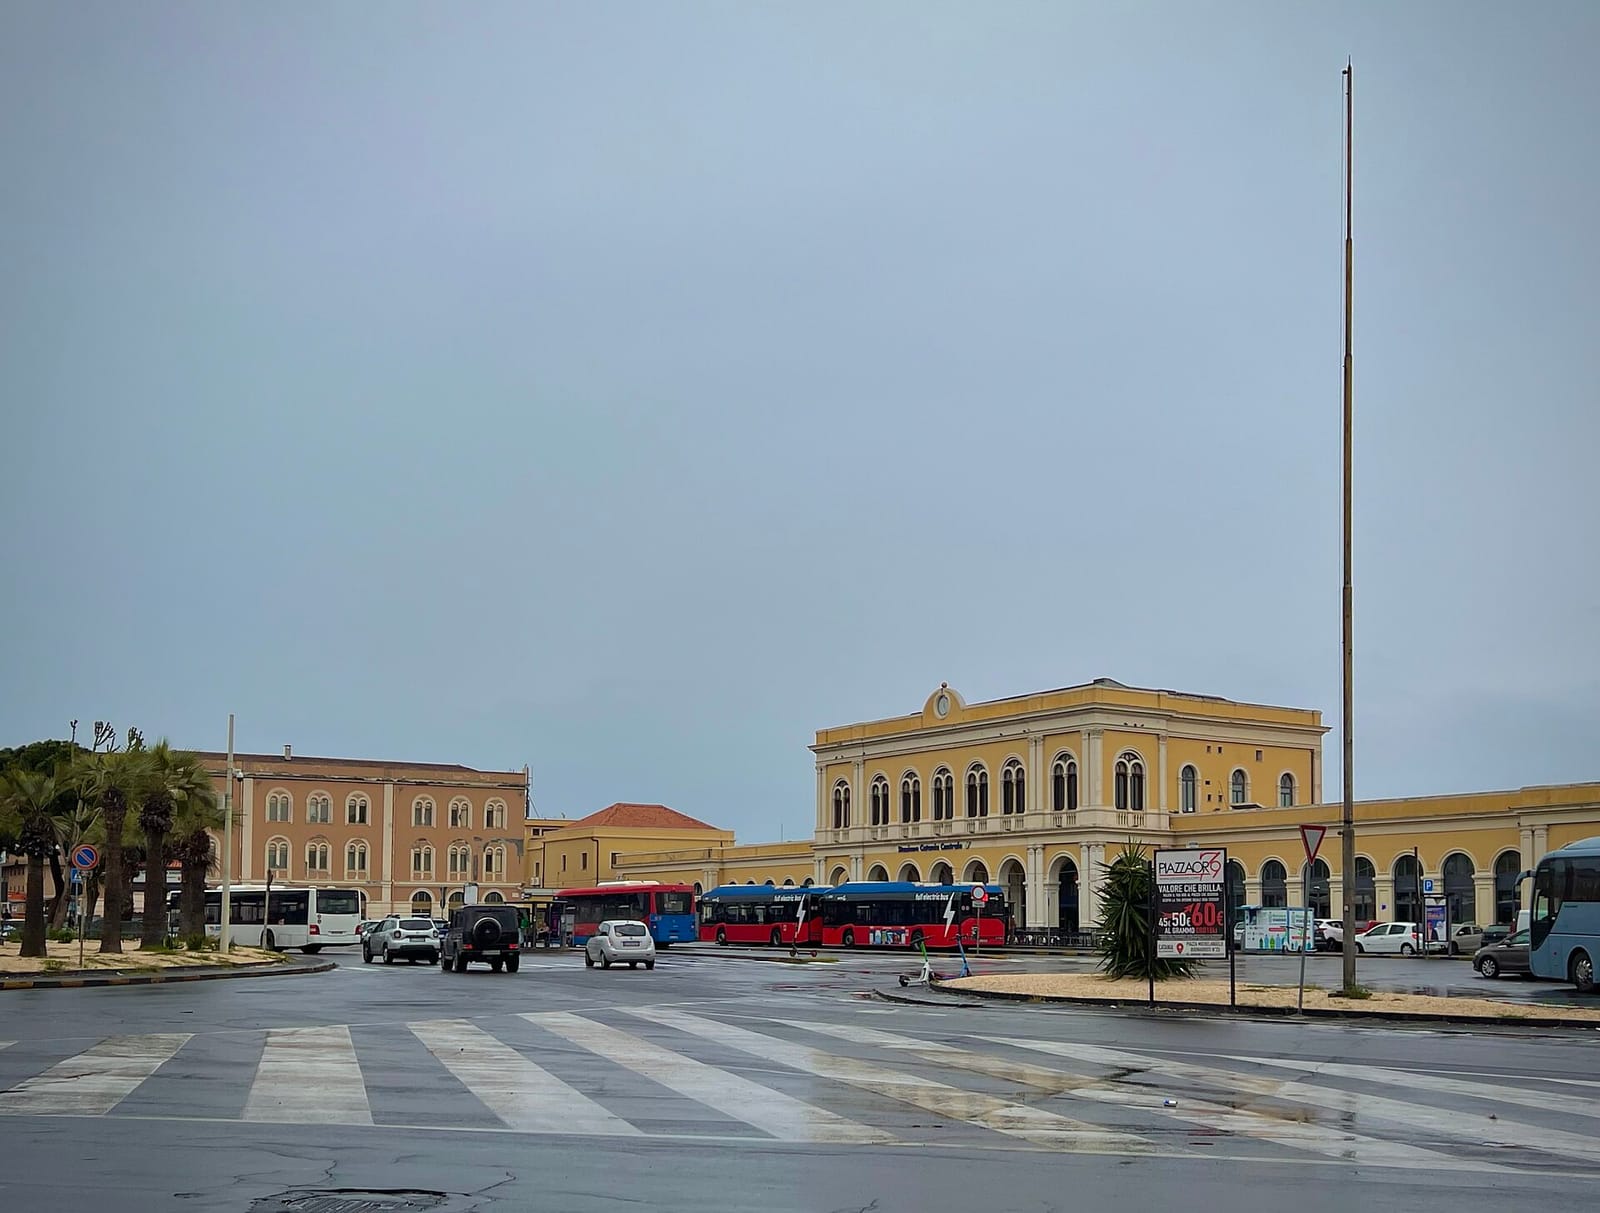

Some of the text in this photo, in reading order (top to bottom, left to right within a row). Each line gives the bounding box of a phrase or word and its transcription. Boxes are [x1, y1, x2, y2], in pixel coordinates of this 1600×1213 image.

[941, 841, 963, 849] Centrale
[1158, 885, 1183, 893] VALORE
[1184, 884, 1197, 892] CHE
[1172, 912, 1191, 926] 50€
[1192, 902, 1223, 926] 60€
